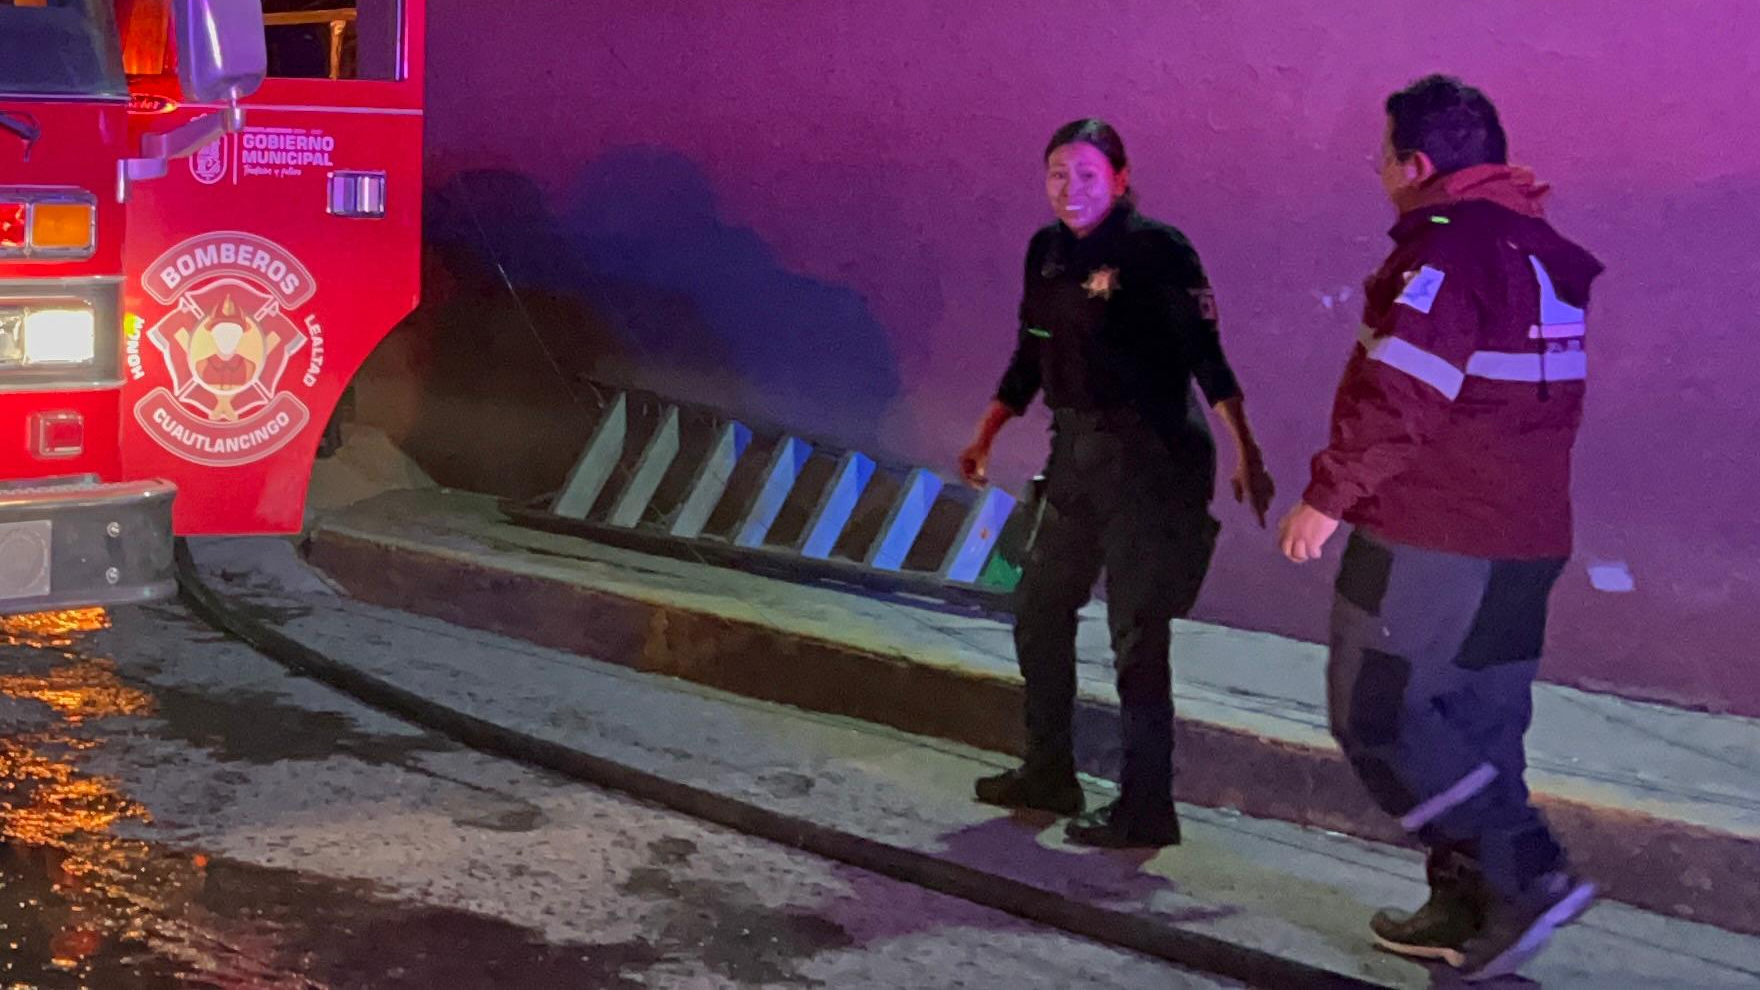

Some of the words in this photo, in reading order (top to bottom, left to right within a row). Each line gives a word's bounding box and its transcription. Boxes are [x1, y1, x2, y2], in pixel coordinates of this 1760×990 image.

[242, 134, 335, 151] GOBIERNO
[242, 150, 334, 166] MUNICIPAL
[160, 243, 300, 295] BOMBEROS
[303, 314, 325, 388] LEALTAD
[152, 408, 290, 453] CUAUTLANCINGO
